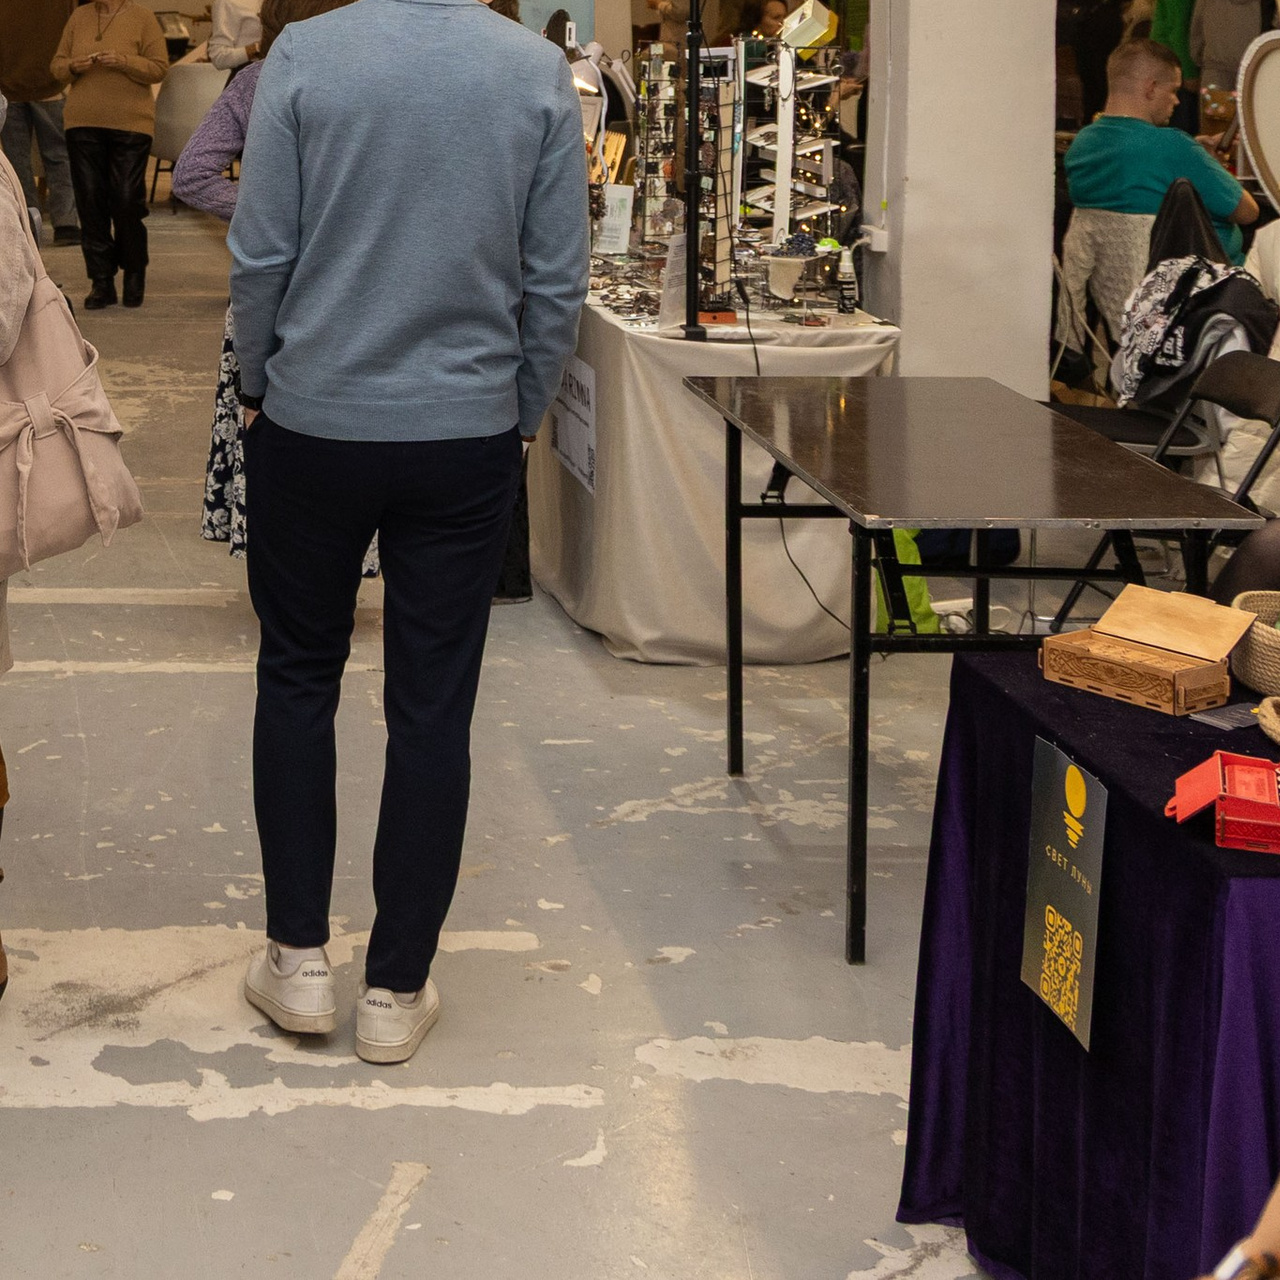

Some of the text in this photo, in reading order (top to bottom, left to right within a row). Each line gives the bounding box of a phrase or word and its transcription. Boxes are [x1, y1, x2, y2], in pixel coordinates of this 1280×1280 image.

[1045, 844, 1093, 895] СВЕТ ЛУНЫ
[366, 999, 392, 1009] adidas
